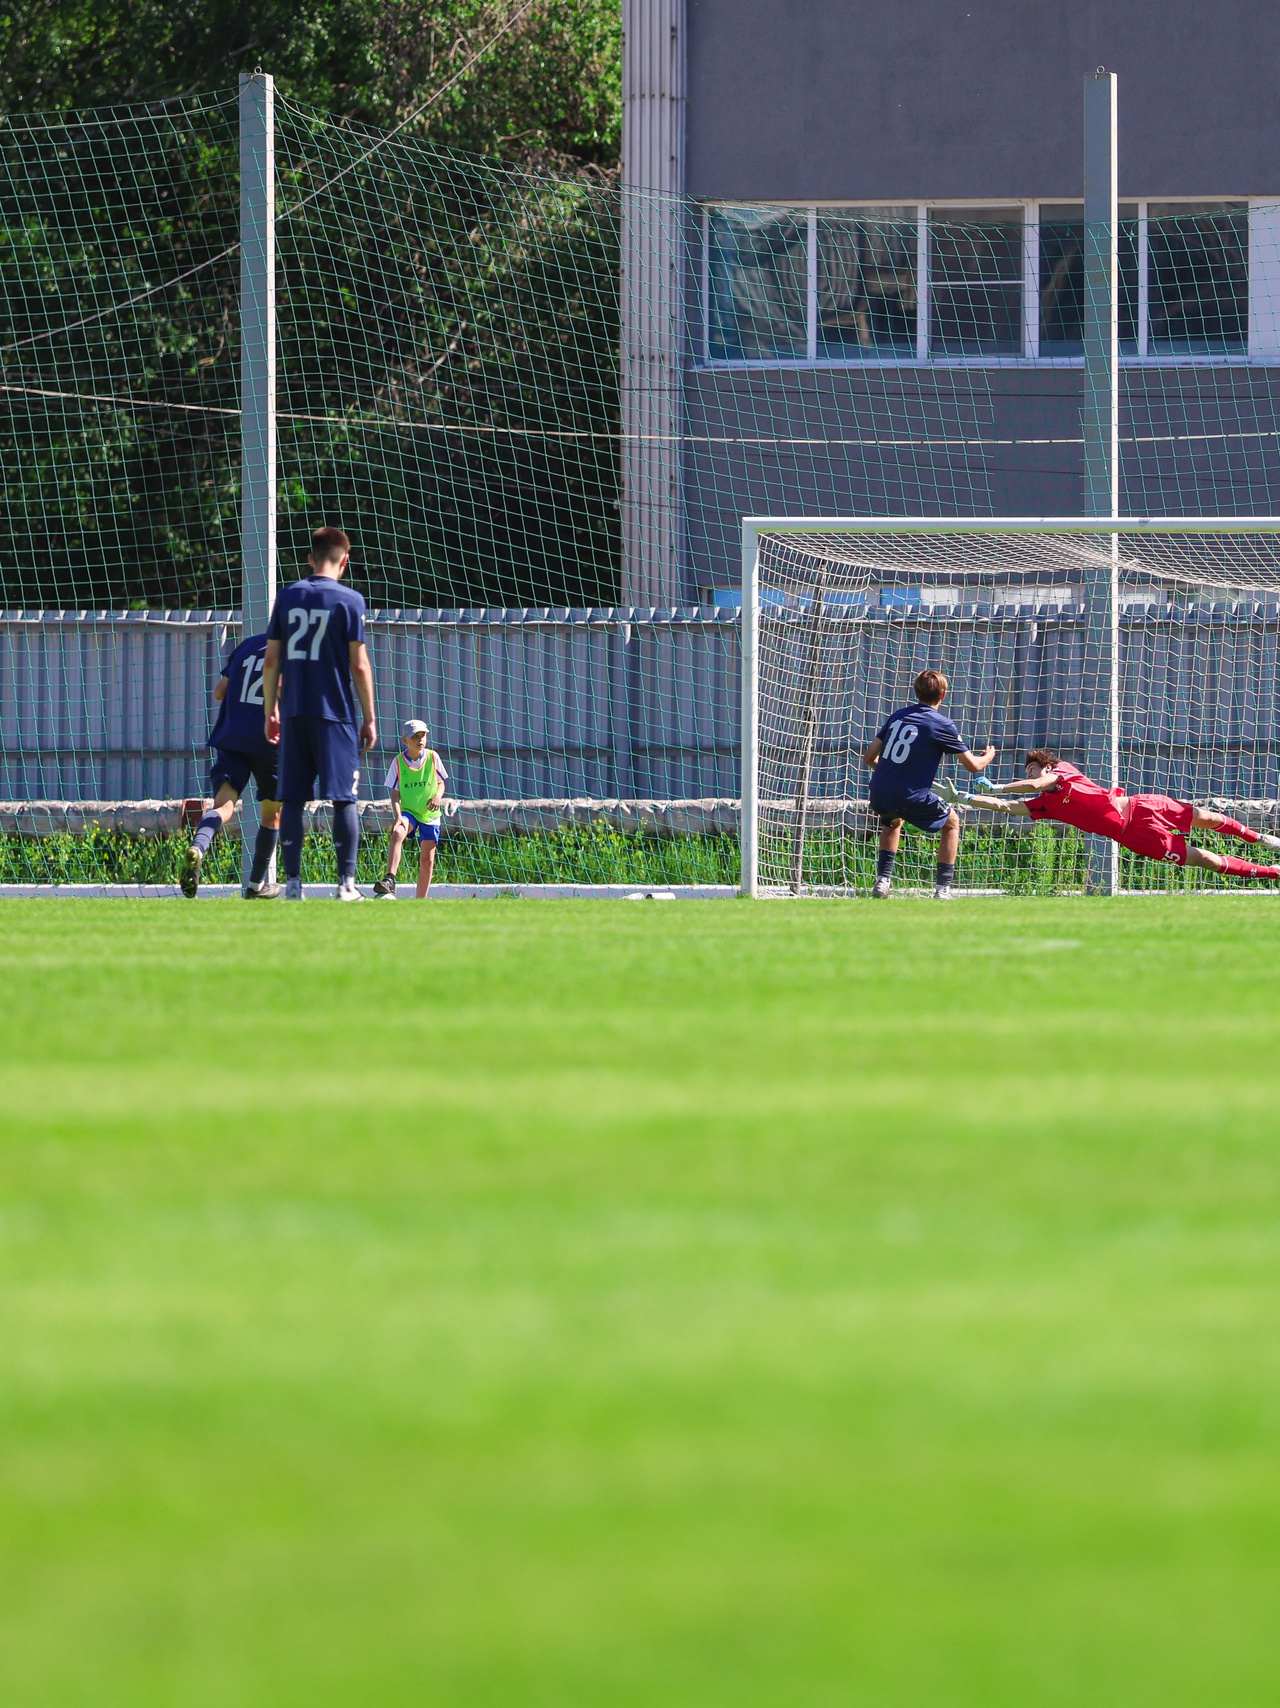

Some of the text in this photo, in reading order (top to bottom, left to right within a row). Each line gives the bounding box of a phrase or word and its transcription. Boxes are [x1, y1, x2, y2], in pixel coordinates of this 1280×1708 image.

[287, 607, 331, 661] 27
[239, 654, 265, 706] 12
[882, 719, 919, 764] 18
[404, 780, 432, 789] KIPSTA
